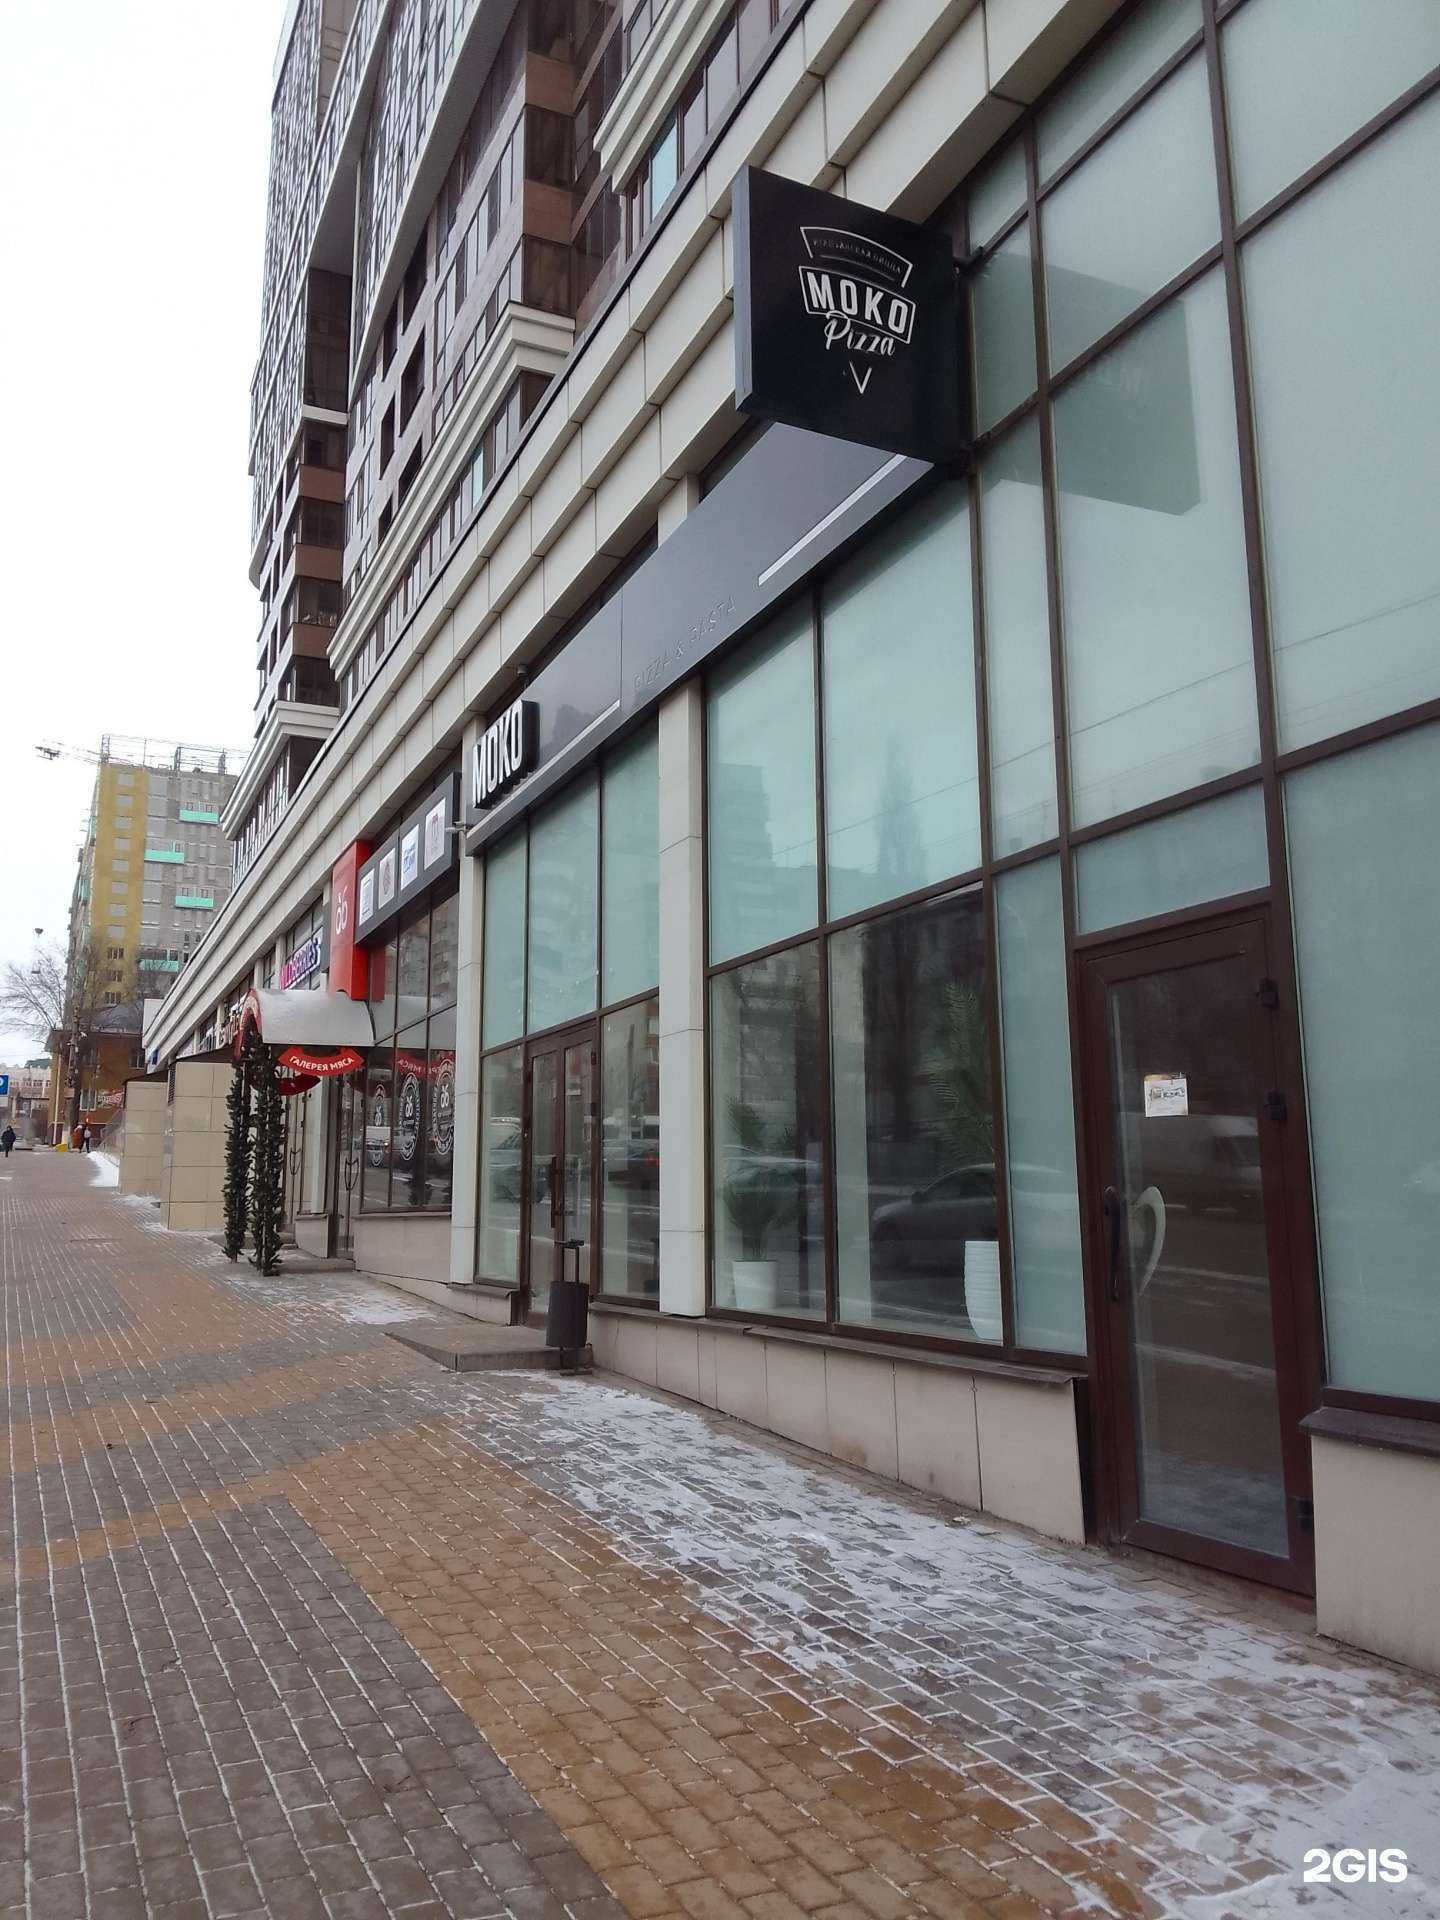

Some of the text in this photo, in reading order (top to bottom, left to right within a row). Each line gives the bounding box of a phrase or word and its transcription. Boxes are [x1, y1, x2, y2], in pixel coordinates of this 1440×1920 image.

[806, 271, 908, 334] MOKO
[823, 309, 896, 356] Pizza
[472, 699, 523, 808] MOKO
[289, 1055, 355, 1071] ГАЛЕРЕЯ МЯСА
